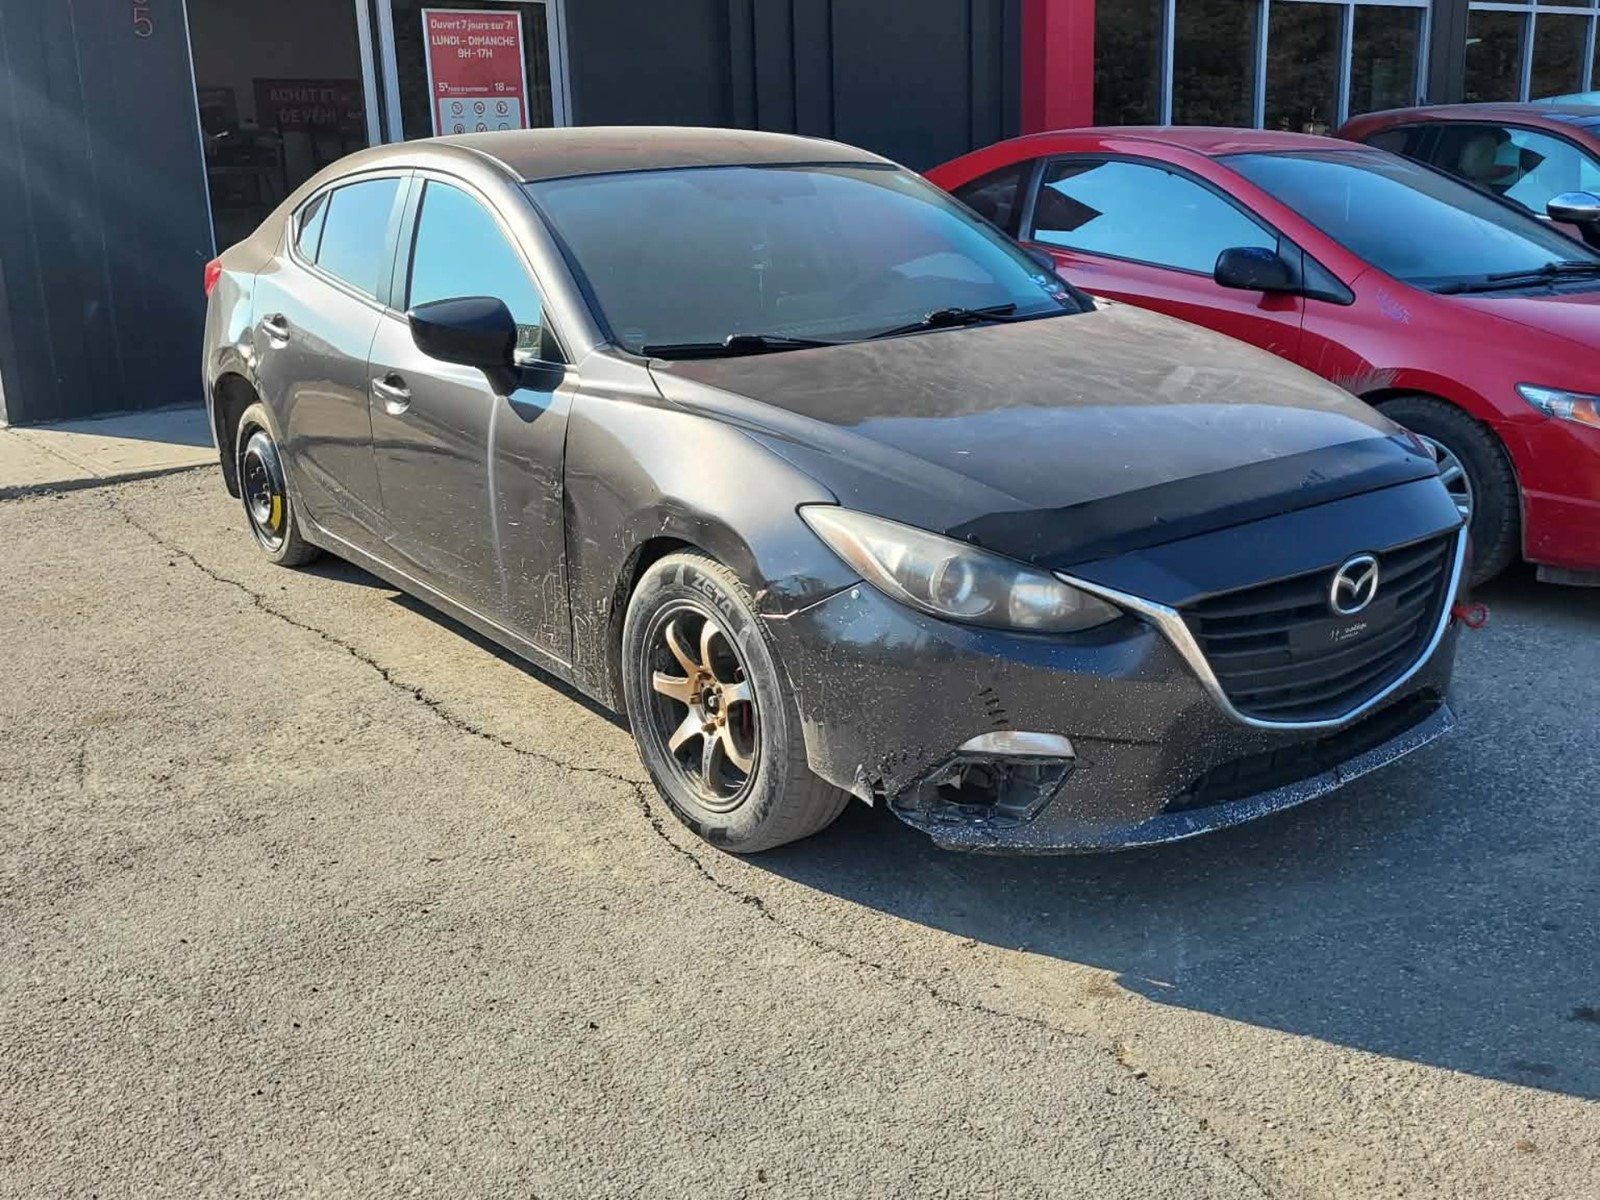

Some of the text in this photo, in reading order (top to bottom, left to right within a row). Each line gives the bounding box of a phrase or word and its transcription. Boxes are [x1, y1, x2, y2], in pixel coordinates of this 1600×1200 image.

[431, 19, 460, 29] Ouvert
[461, 20, 467, 29] 7
[467, 20, 489, 31] jours
[491, 22, 504, 30] sur
[432, 36, 459, 45] LUNDI
[468, 36, 515, 46] DIMANCHE
[270, 88, 318, 101] ACHAT
[691, 572, 734, 618] ZETA
